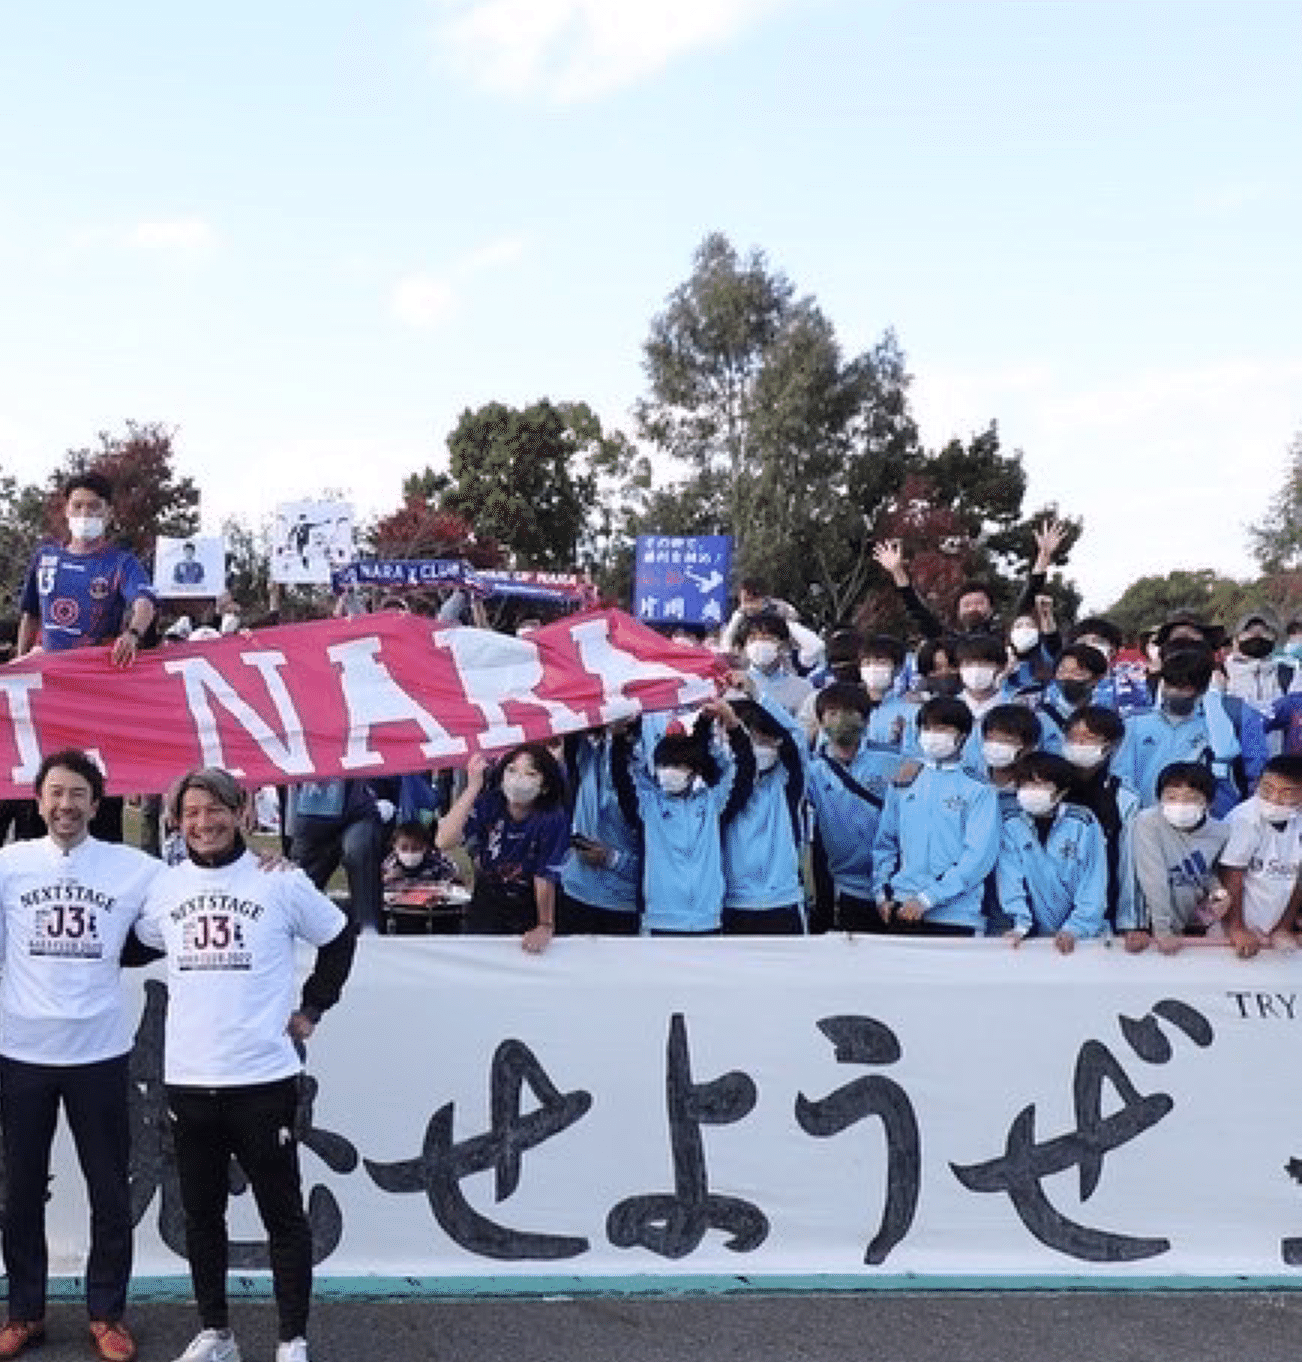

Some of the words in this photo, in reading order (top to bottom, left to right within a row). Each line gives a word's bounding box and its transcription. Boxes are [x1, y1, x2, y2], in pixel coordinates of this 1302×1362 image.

[164, 618, 718, 779] NARA
[47, 905, 86, 939] J3
[194, 915, 230, 950] J3
[1226, 991, 1297, 1019] TRY
